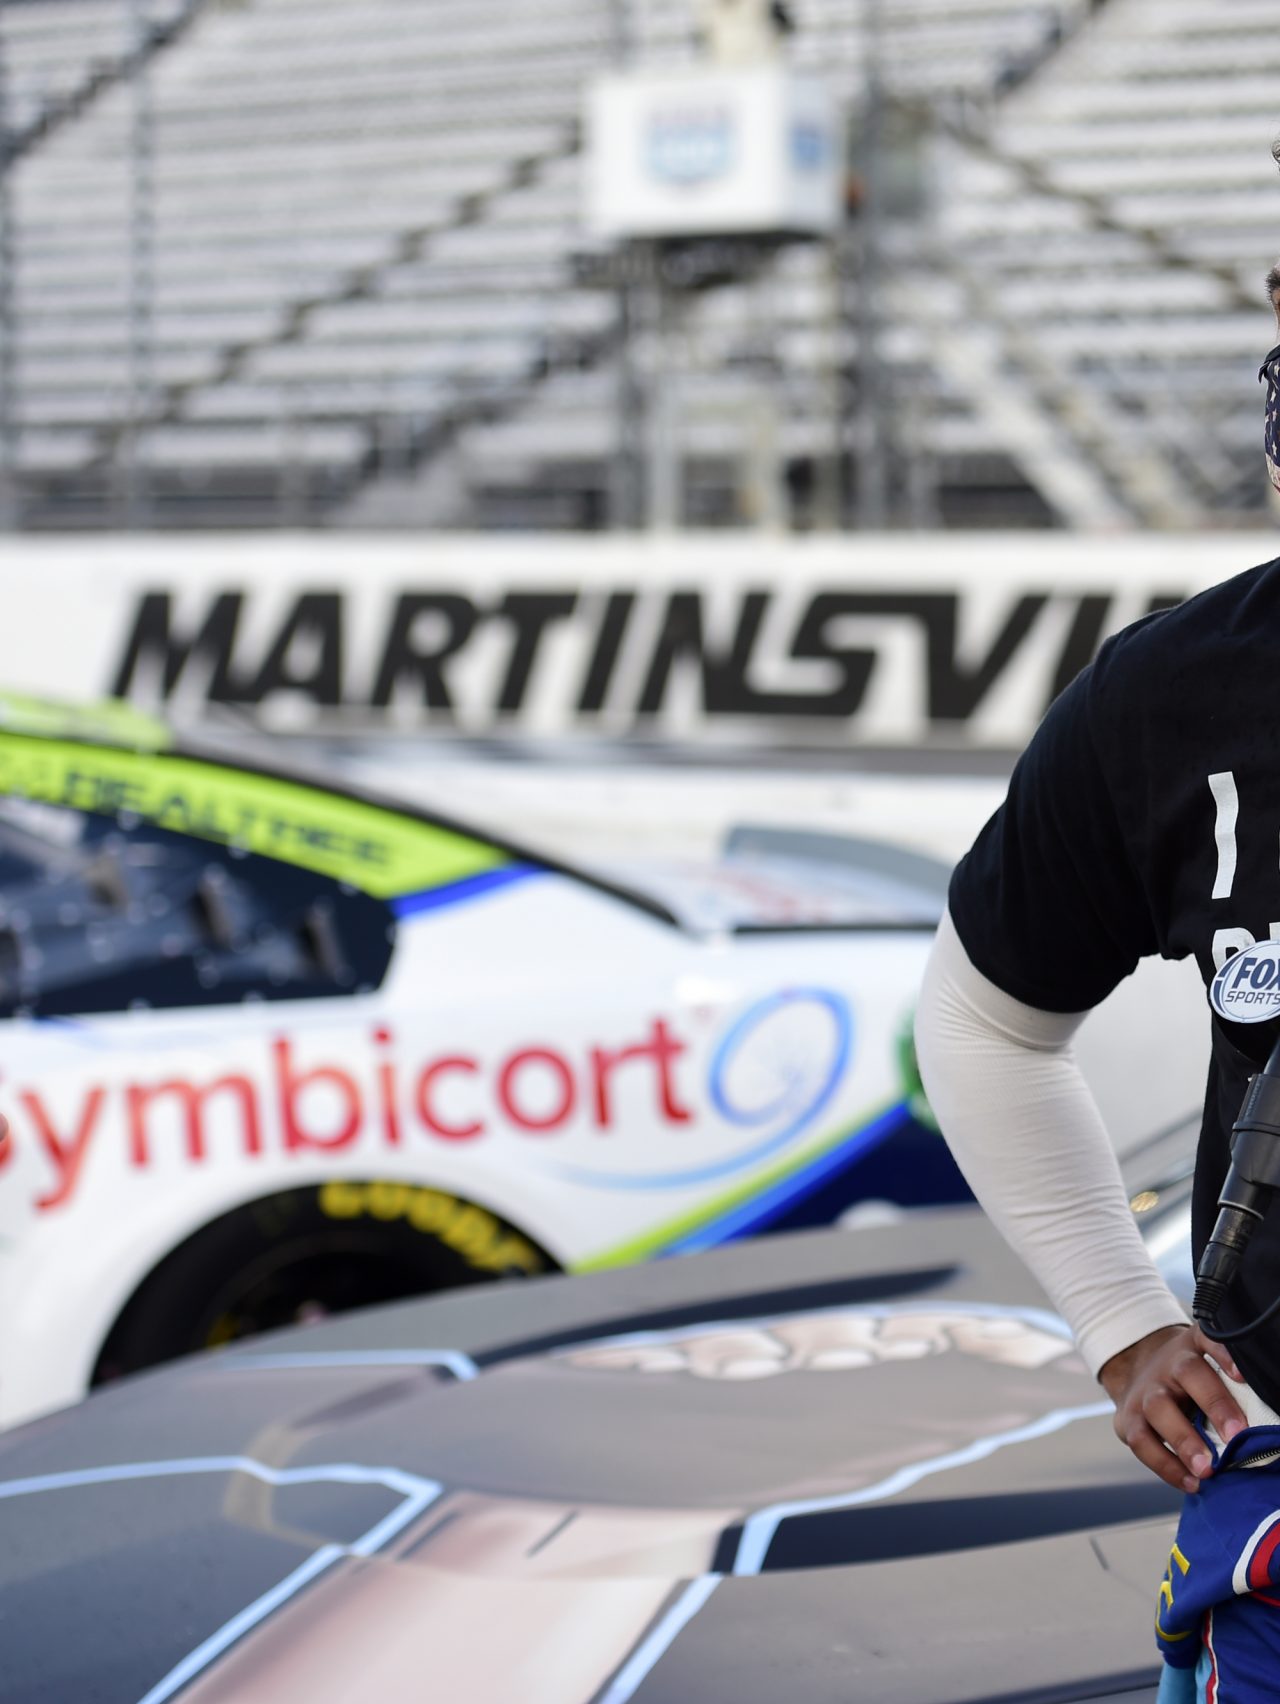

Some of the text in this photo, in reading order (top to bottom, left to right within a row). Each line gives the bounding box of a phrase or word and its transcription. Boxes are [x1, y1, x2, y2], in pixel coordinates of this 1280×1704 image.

[110, 590, 1190, 718] MARTINSVI
[1208, 771, 1239, 899] I
[0, 1018, 692, 1215] ymbicort
